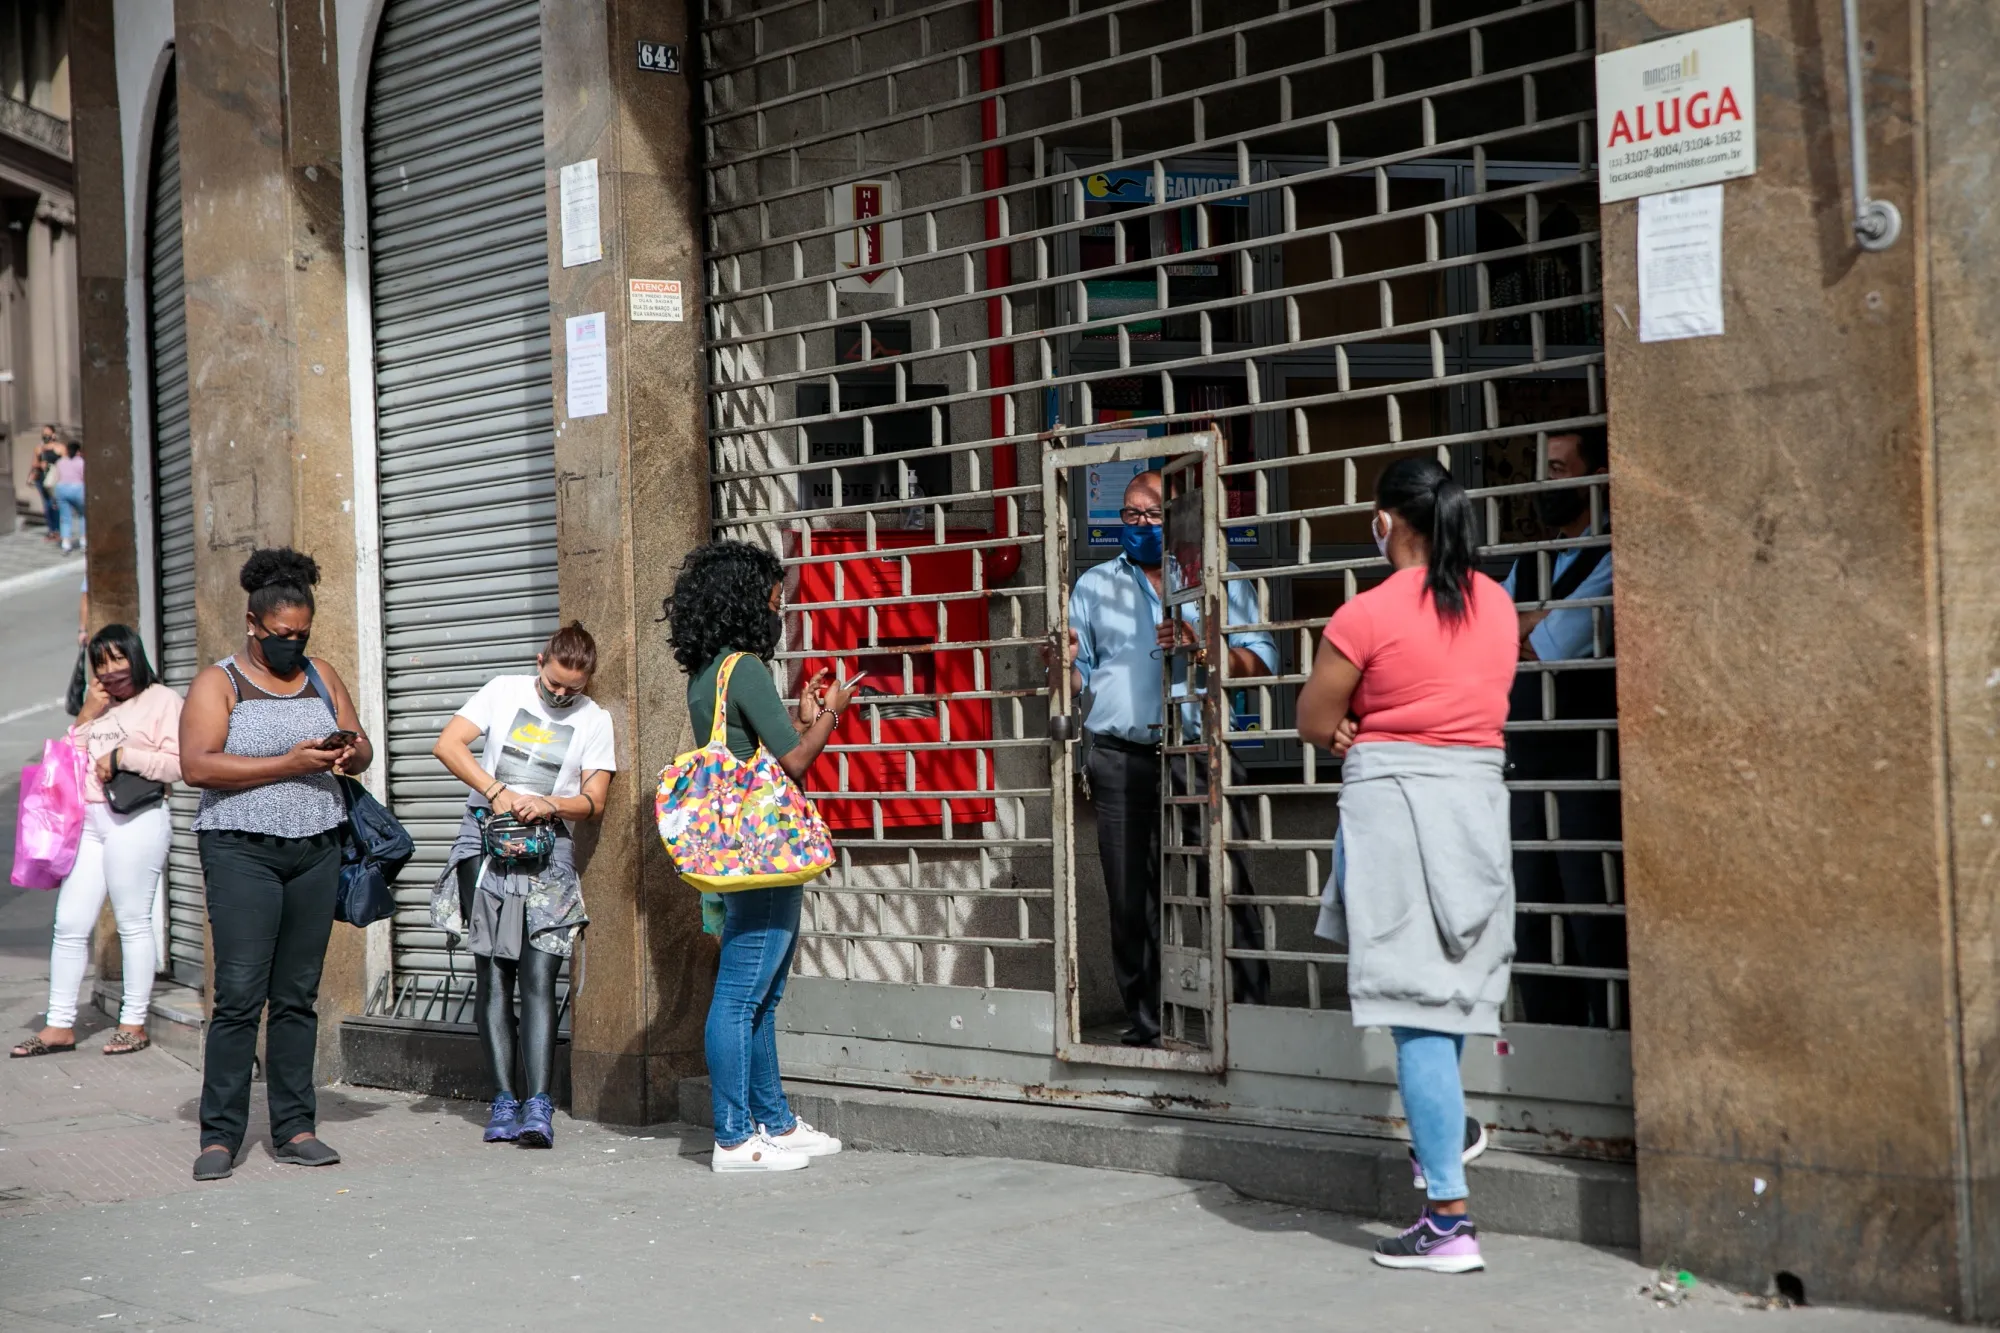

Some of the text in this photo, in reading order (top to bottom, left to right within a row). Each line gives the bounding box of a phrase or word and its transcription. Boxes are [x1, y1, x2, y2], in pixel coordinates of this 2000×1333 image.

[1607, 85, 1742, 148] ALUGA
[1609, 149, 1741, 183] locacao@administer.com.br
[1145, 176, 1157, 197] A
[812, 442, 932, 456] PERMNEC
